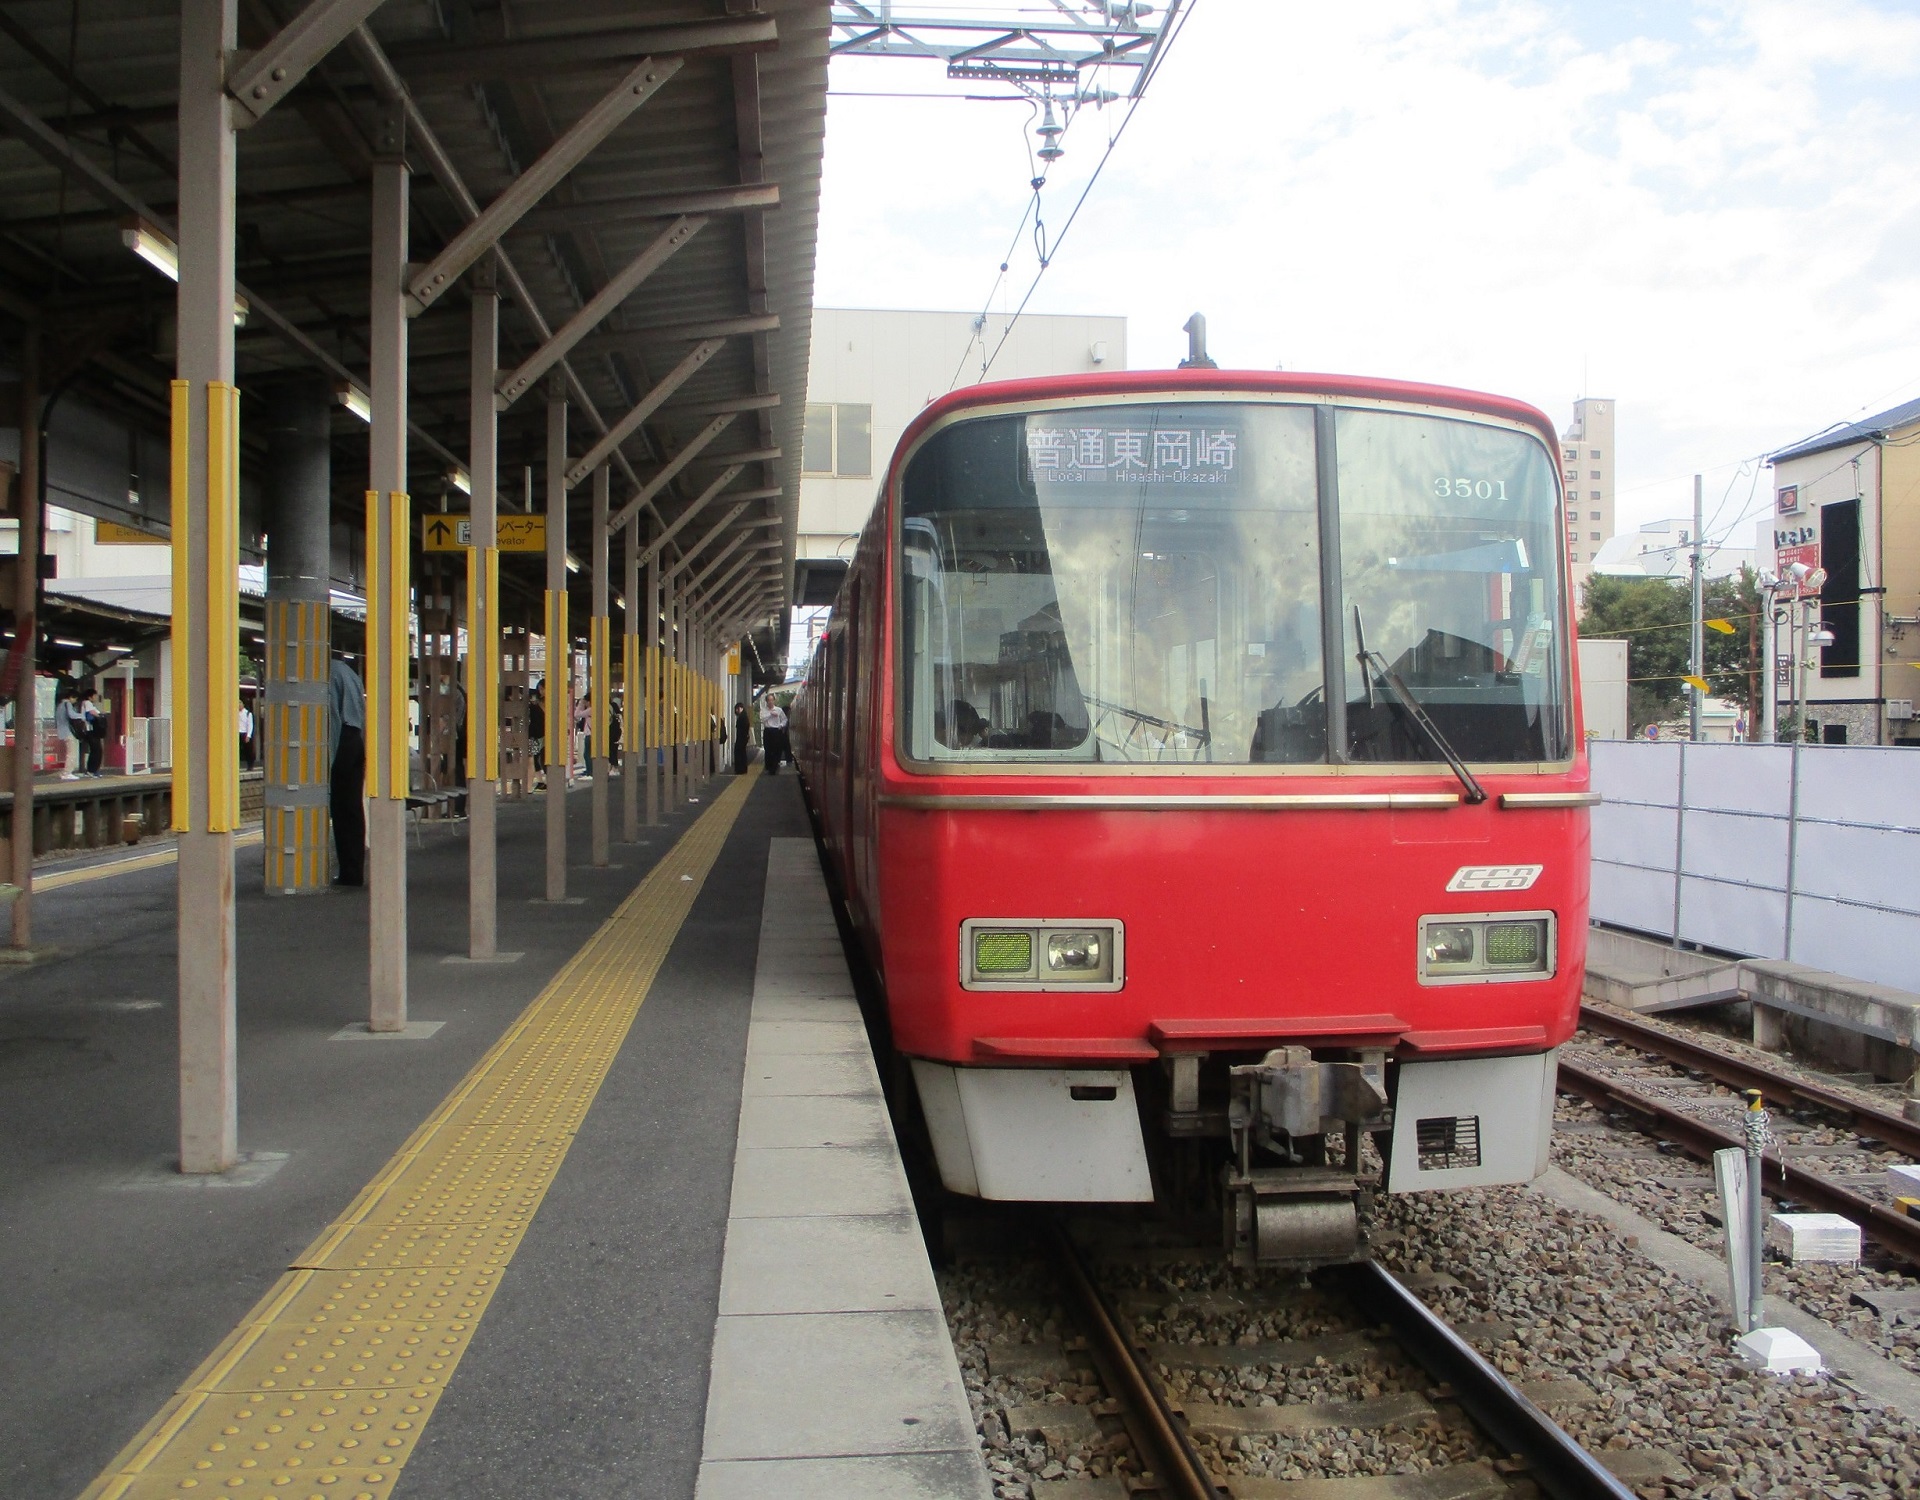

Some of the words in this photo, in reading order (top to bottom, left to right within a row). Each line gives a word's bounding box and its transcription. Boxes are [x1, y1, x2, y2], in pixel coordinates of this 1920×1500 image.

[1048, 470, 1087, 482] Local
[1115, 470, 1227, 483] Higashi-Okazaki
[1434, 477, 1509, 501] 3501
